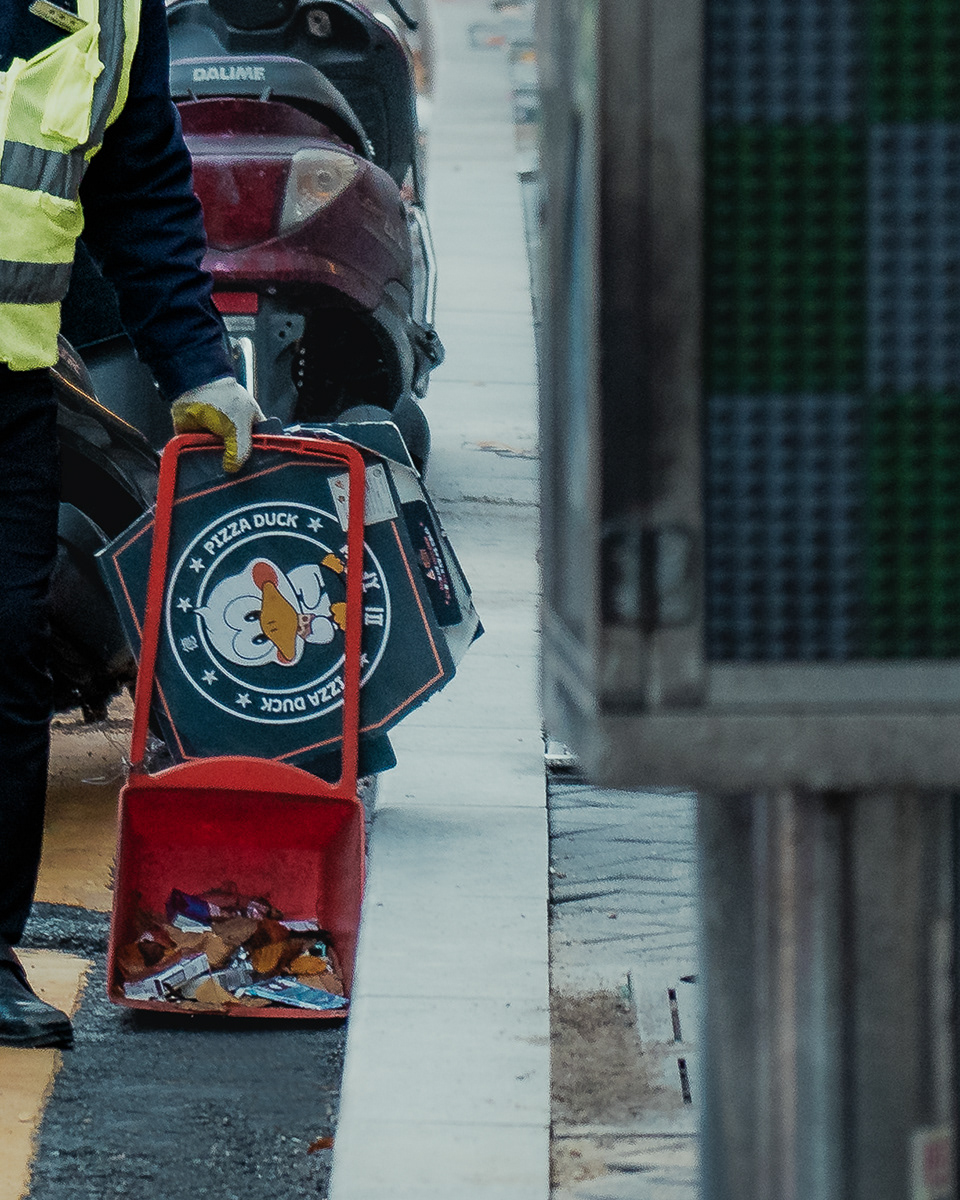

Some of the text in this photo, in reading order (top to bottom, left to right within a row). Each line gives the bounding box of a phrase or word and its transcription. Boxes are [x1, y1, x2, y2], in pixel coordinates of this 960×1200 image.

[203, 512, 300, 556] PIZZA DUCK
[260, 675, 346, 713] IZZA DUCK
